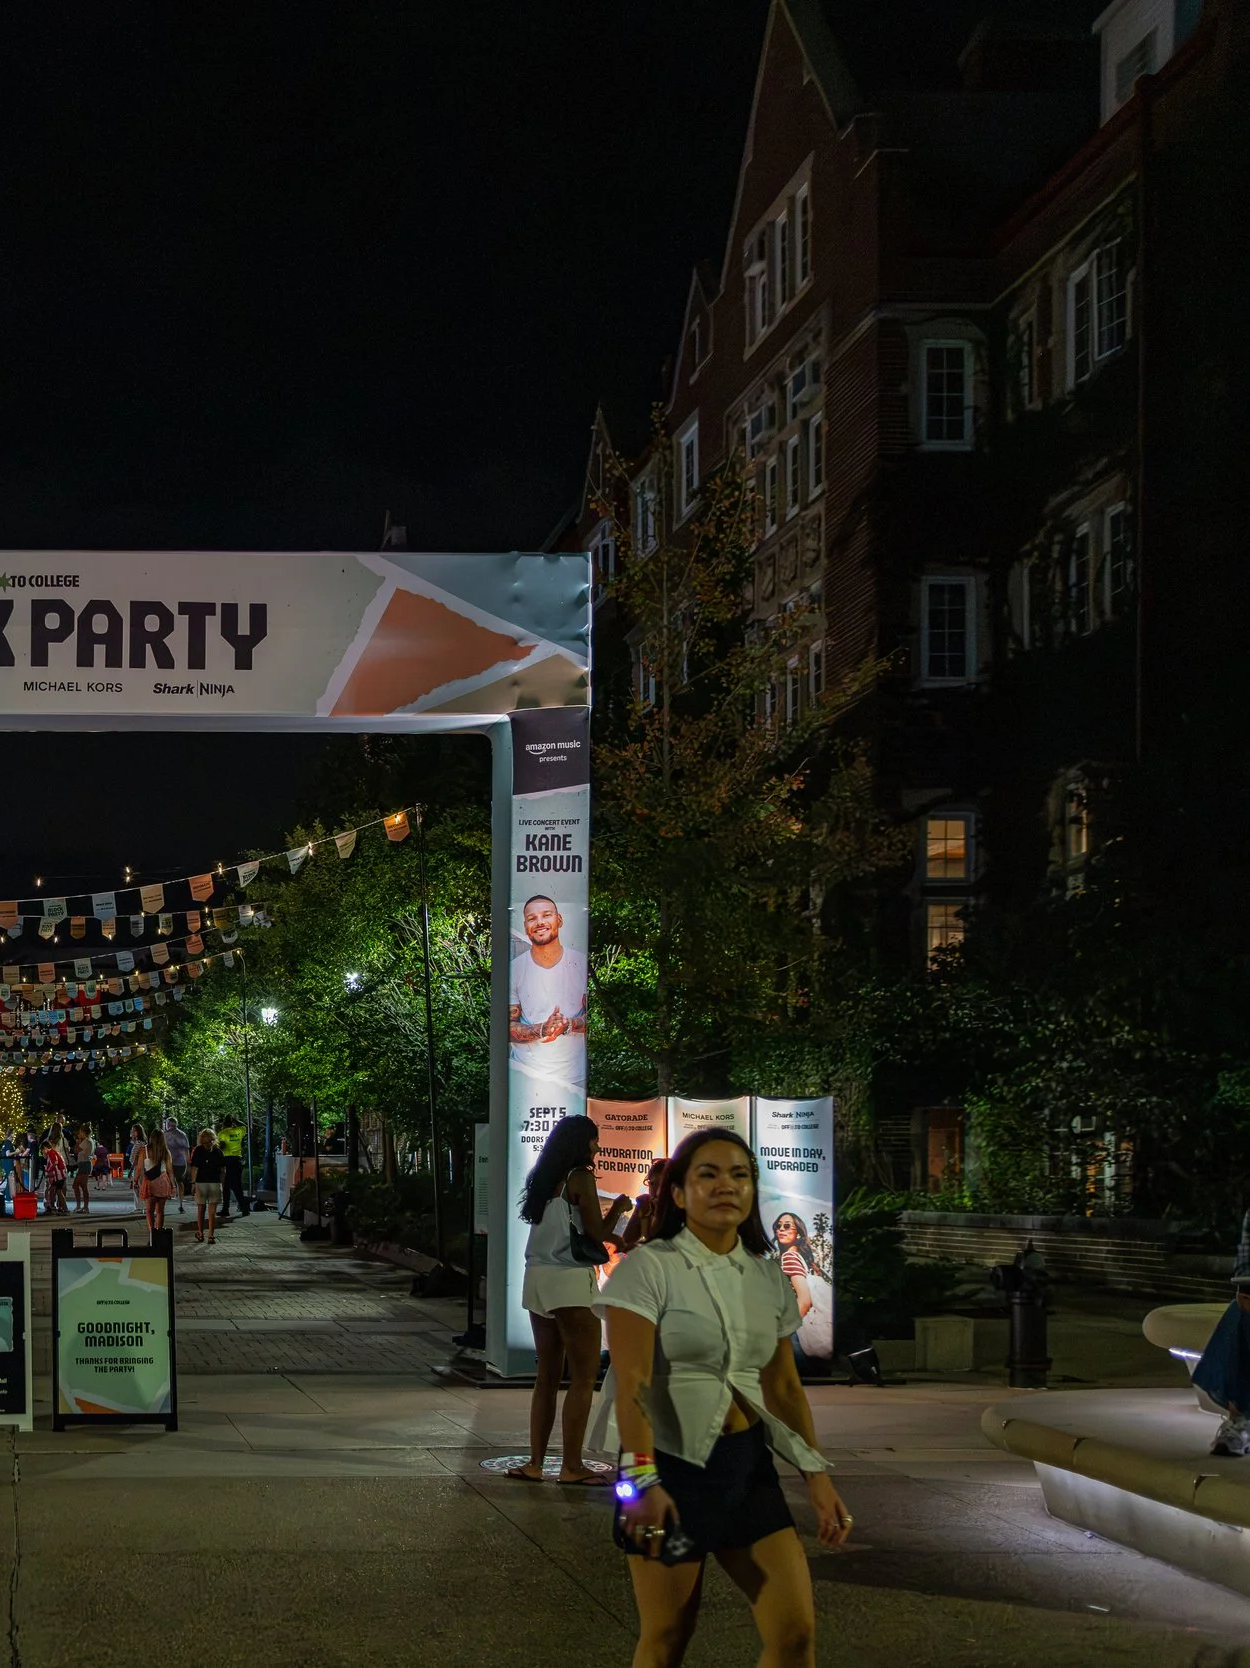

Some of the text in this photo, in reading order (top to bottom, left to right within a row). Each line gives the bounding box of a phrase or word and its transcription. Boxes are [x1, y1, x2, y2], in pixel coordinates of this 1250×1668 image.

[10, 575, 26, 588] TO
[28, 575, 80, 588] COLLEGE
[30, 599, 268, 670] PARTY
[23, 681, 82, 692] MICHAEL
[87, 682, 123, 693] KORS
[525, 740, 581, 752] amazon music
[539, 755, 567, 763] presents
[525, 834, 572, 852] KANE
[516, 855, 582, 873] BROWN
[529, 1107, 567, 1118] SEPT 5
[605, 1113, 648, 1122] GATORADE
[682, 1112, 735, 1121] MICHAEL KORS
[771, 1111, 815, 1119] Shark NINJA
[523, 1120, 549, 1132] 7:30
[599, 1147, 653, 1160] HYDRATION
[760, 1147, 826, 1161] MOVE IN DAY,
[598, 1160, 651, 1174] FOR DAY ON
[767, 1159, 819, 1173] UPGRADED
[77, 1322, 155, 1335] GOODNIGHT,
[85, 1335, 144, 1347] MADISON
[75, 1357, 154, 1365] THANKS FOR BRINGING
